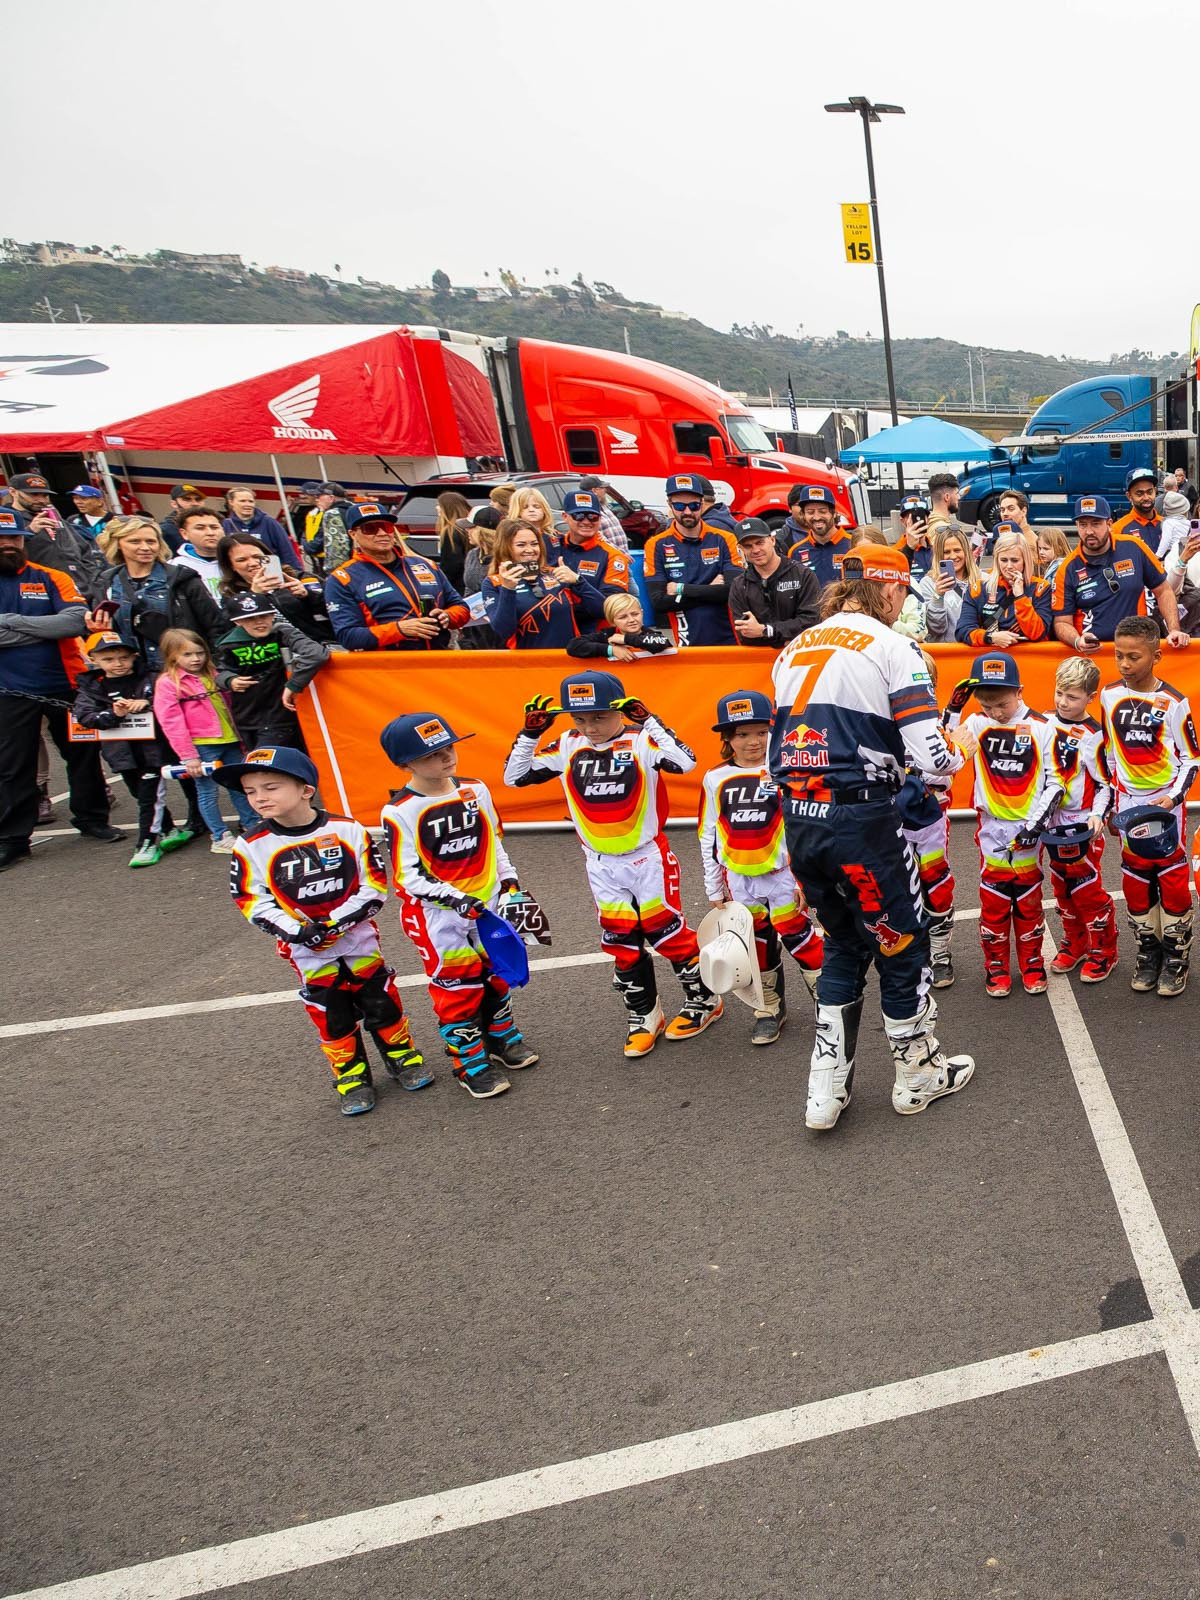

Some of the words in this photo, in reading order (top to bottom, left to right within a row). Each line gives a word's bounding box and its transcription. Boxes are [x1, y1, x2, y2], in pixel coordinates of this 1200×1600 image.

[848, 242, 871, 260] 15
[272, 426, 338, 441] HONDA
[1077, 431, 1168, 440] www.MotoConcepts.com
[787, 627, 875, 653] SSINGER
[789, 649, 836, 716] 7
[731, 703, 747, 711] KTM
[424, 724, 439, 735] KTM
[1125, 729, 1153, 743] KTM
[1068, 738, 1079, 746] 9
[617, 752, 631, 760] 13
[800, 750, 830, 767] Bull
[990, 759, 1024, 772] KTM
[583, 781, 625, 796] KTM
[763, 781, 775, 789] 12
[467, 800, 477, 809] 14
[791, 800, 830, 818] THOR
[731, 809, 768, 823] KTM
[427, 811, 476, 838] TLD
[439, 835, 478, 855] KTM
[322, 847, 340, 859] 15
[297, 877, 343, 899] KTM
[841, 864, 884, 912] KTM
[304, 934, 321, 947] LD
